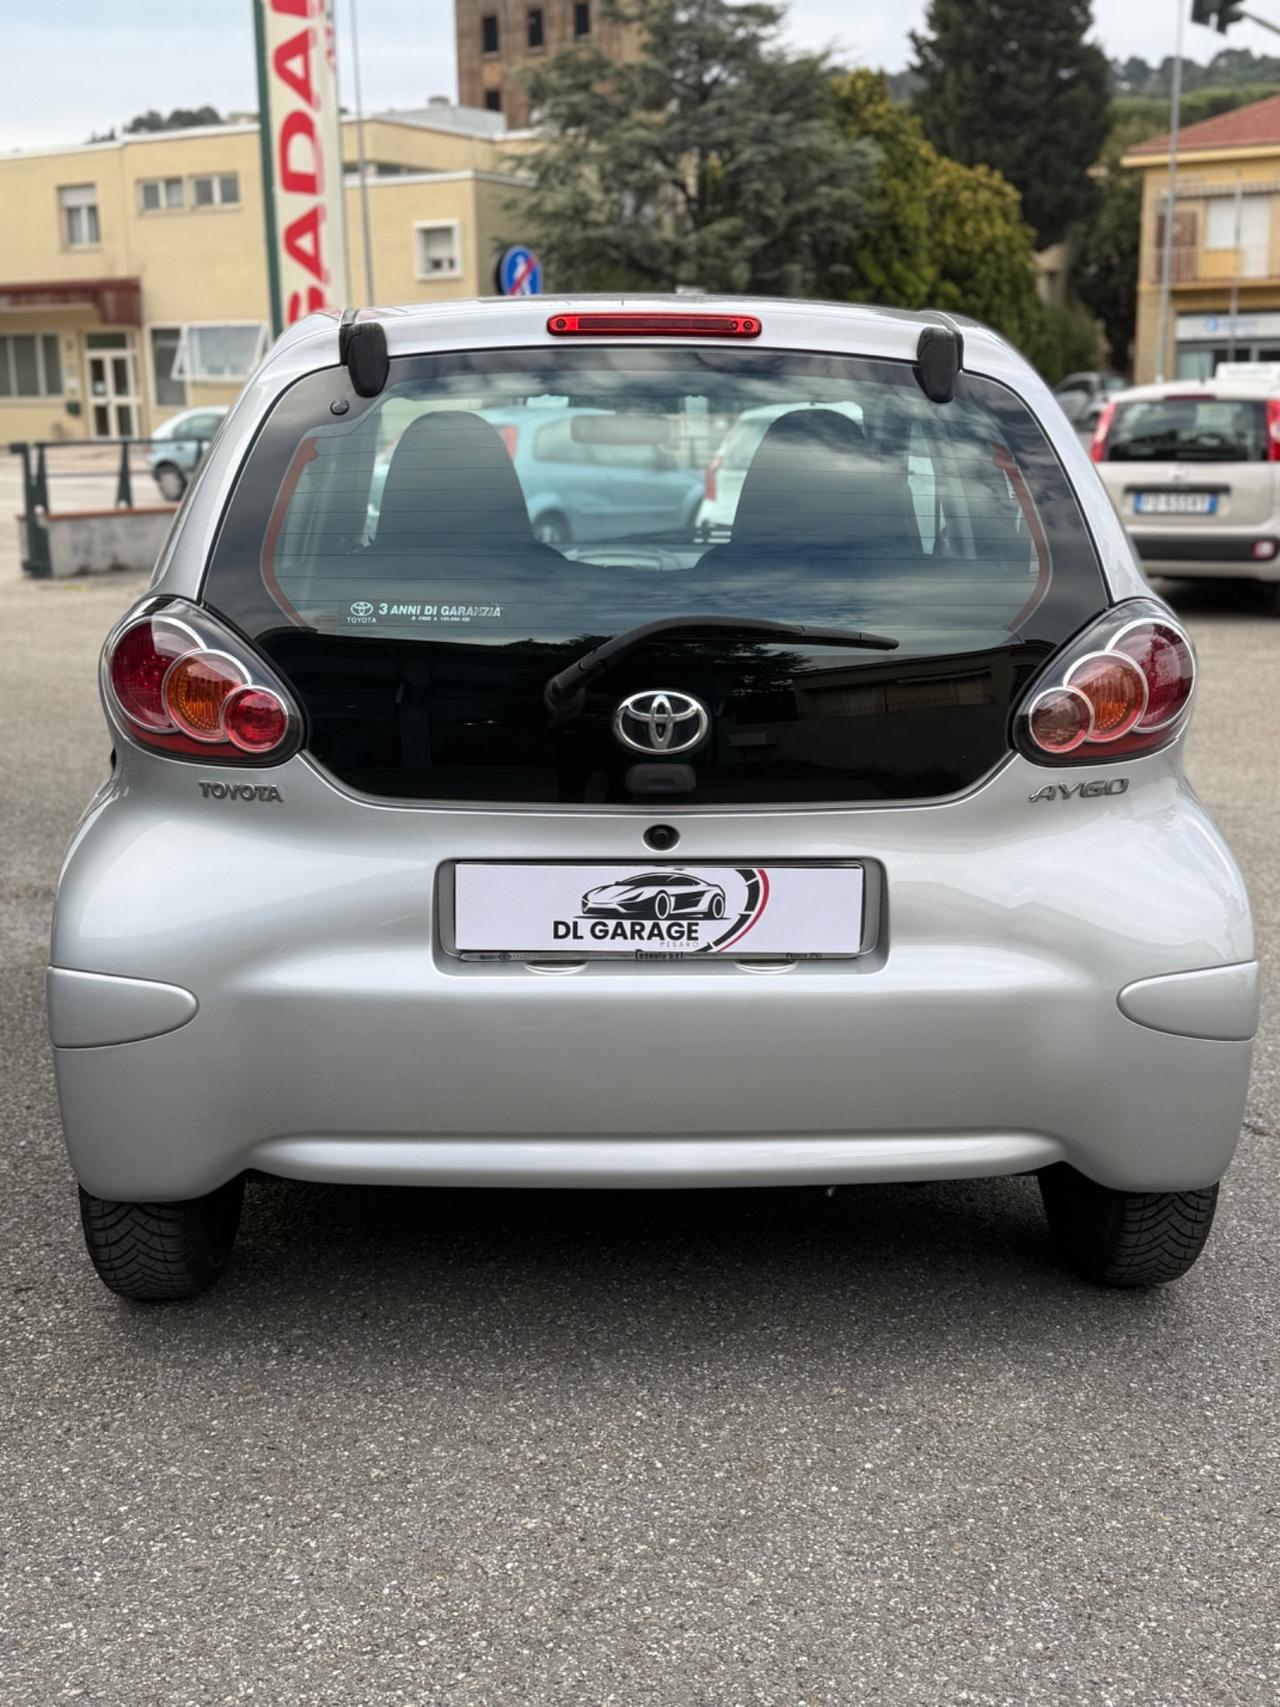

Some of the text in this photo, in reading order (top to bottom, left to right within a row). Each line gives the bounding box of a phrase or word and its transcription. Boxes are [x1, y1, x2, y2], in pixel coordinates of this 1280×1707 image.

[378, 602, 388, 615] 3
[390, 604, 421, 616] ANNI
[424, 605, 437, 616] DI
[347, 616, 377, 624] TOYOTA
[199, 780, 284, 803] TOYOTA
[1028, 778, 1130, 803] AYGO
[553, 920, 700, 941] DL GARAGE
